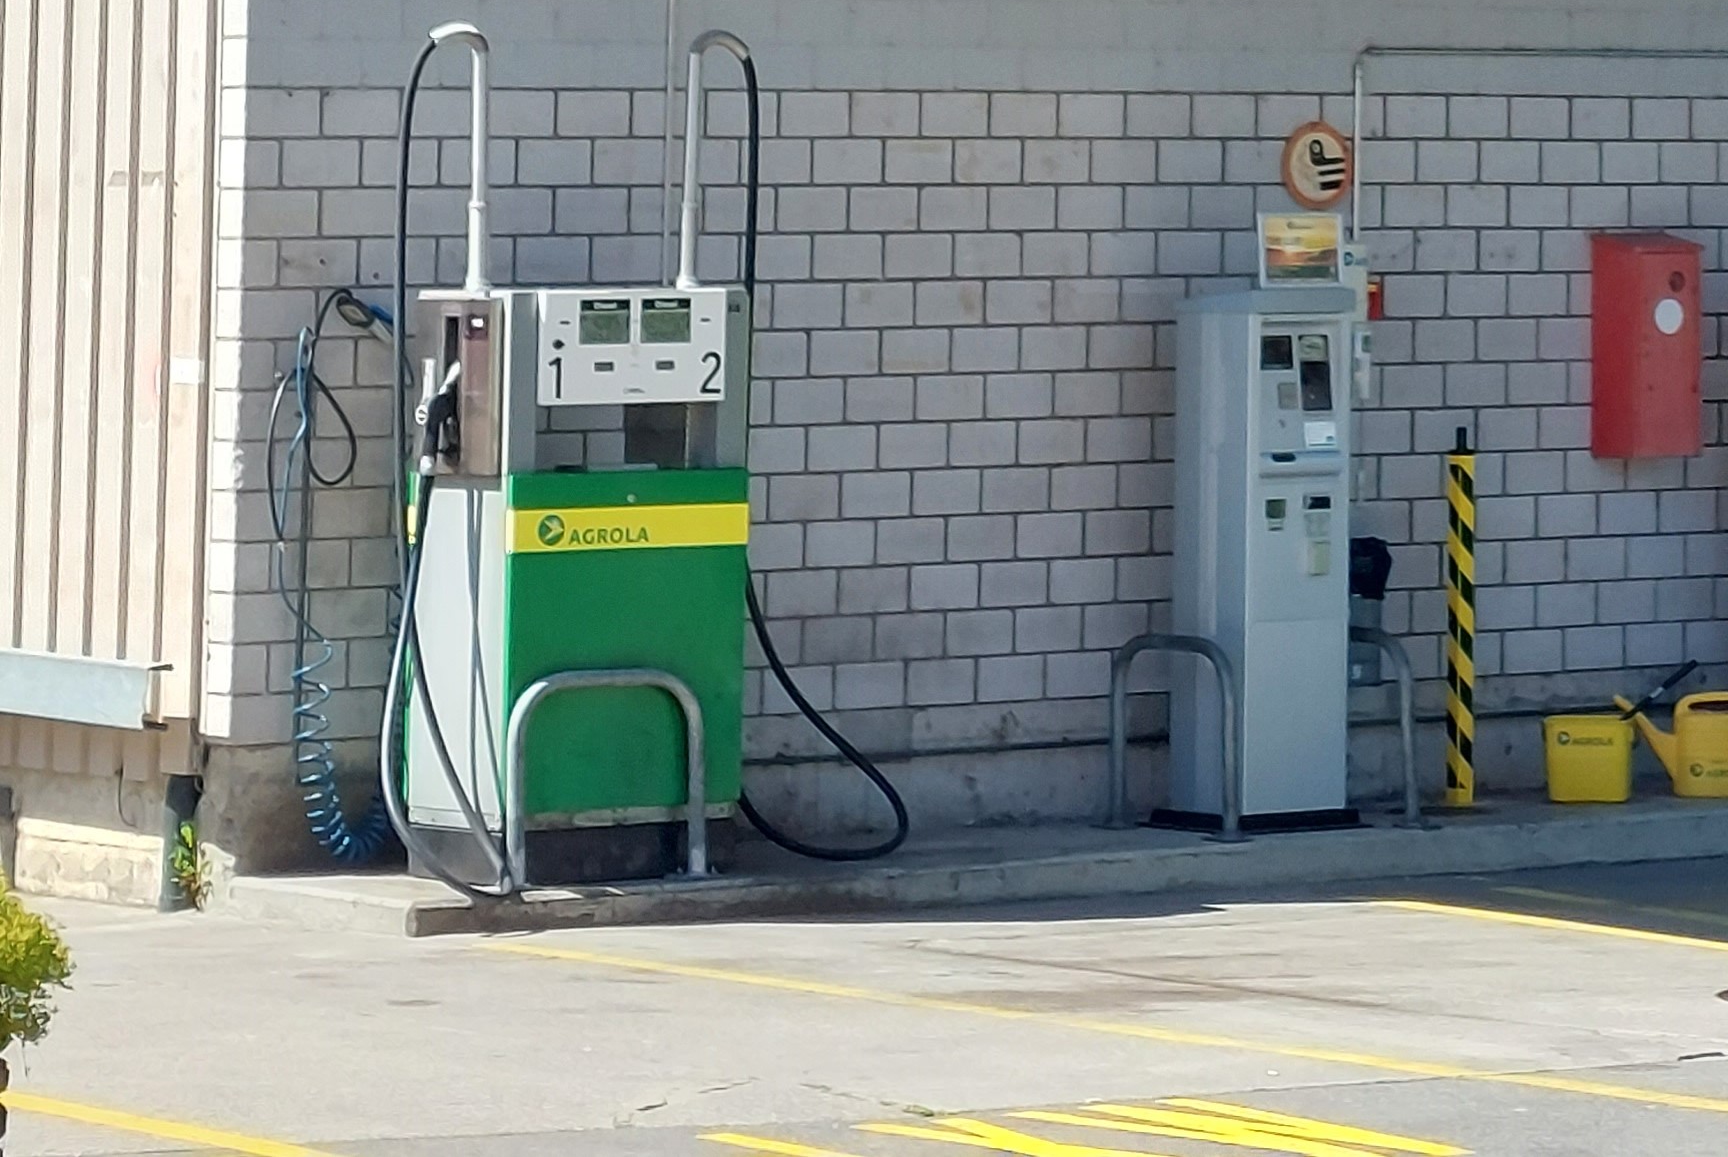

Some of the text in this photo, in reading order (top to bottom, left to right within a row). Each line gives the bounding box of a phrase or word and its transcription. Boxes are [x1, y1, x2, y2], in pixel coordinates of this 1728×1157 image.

[548, 356, 562, 399] 1
[700, 351, 722, 394] 2
[568, 526, 649, 546] AGROLA
